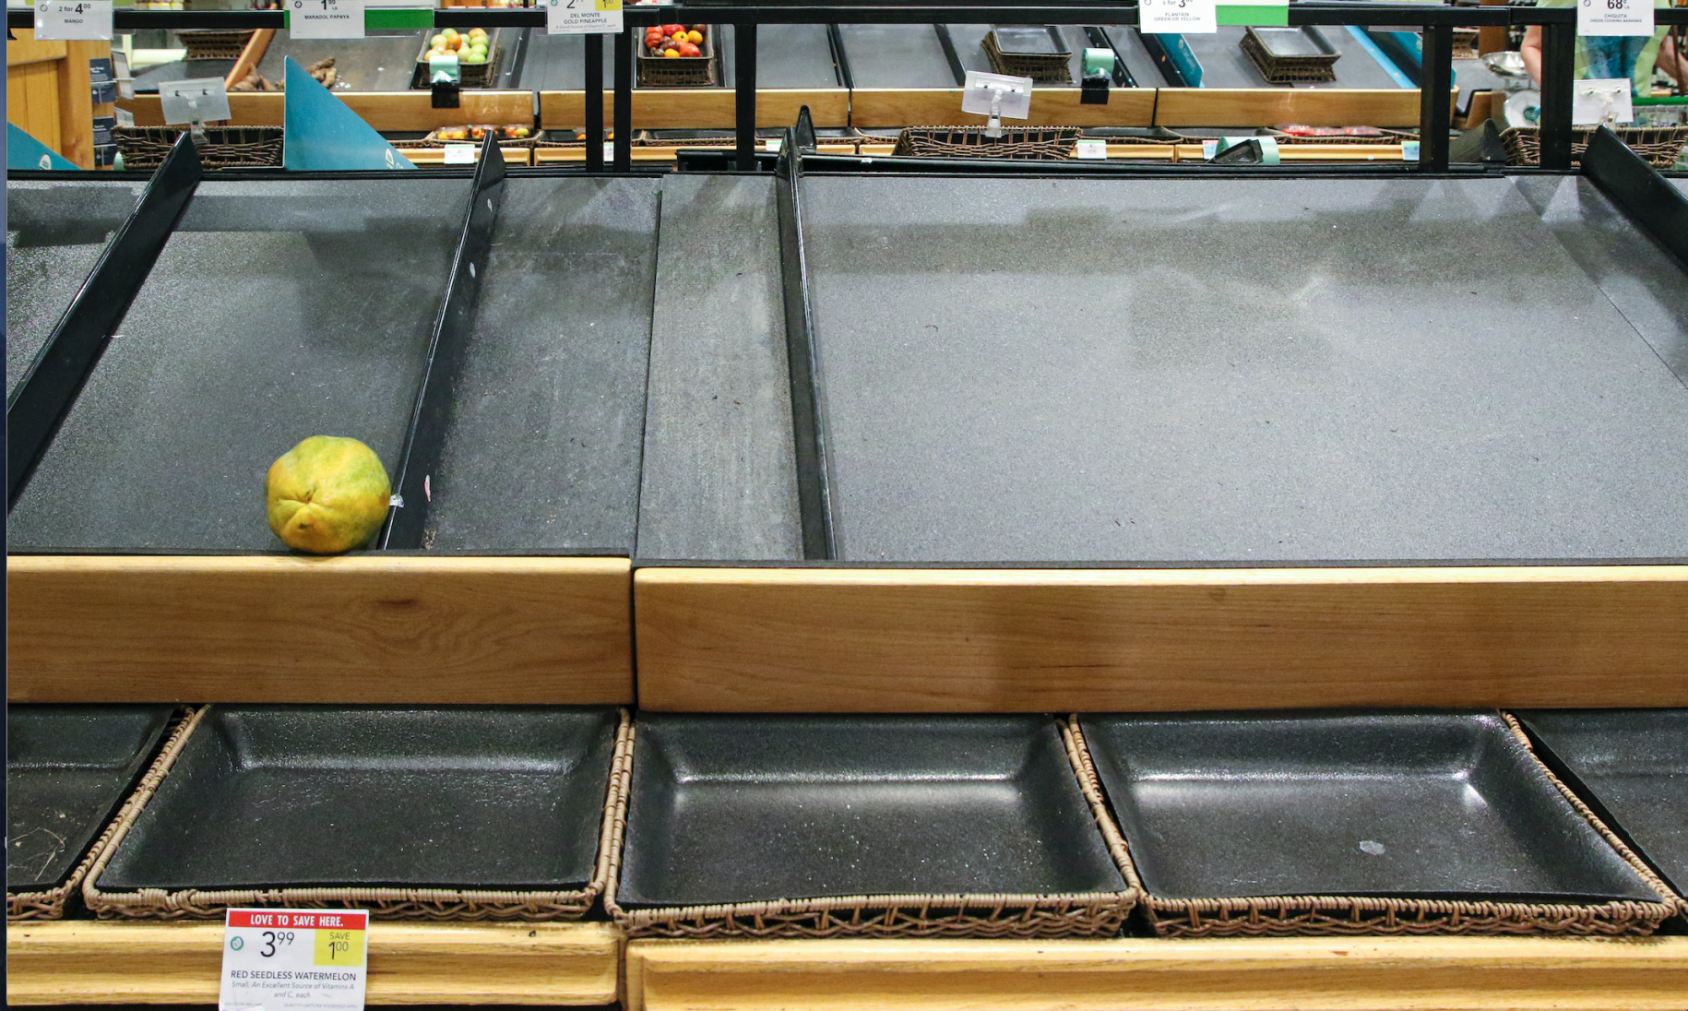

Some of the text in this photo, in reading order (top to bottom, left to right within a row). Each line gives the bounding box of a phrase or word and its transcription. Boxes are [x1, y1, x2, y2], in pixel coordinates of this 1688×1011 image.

[250, 914, 344, 927] LOVE TO SAVE HERE.
[329, 932, 350, 940] SAVE
[260, 931, 295, 957] 399
[328, 941, 349, 960] 100
[230, 970, 357, 981] RED SEEDLESS WATERMELON
[231, 981, 250, 989] Small,
